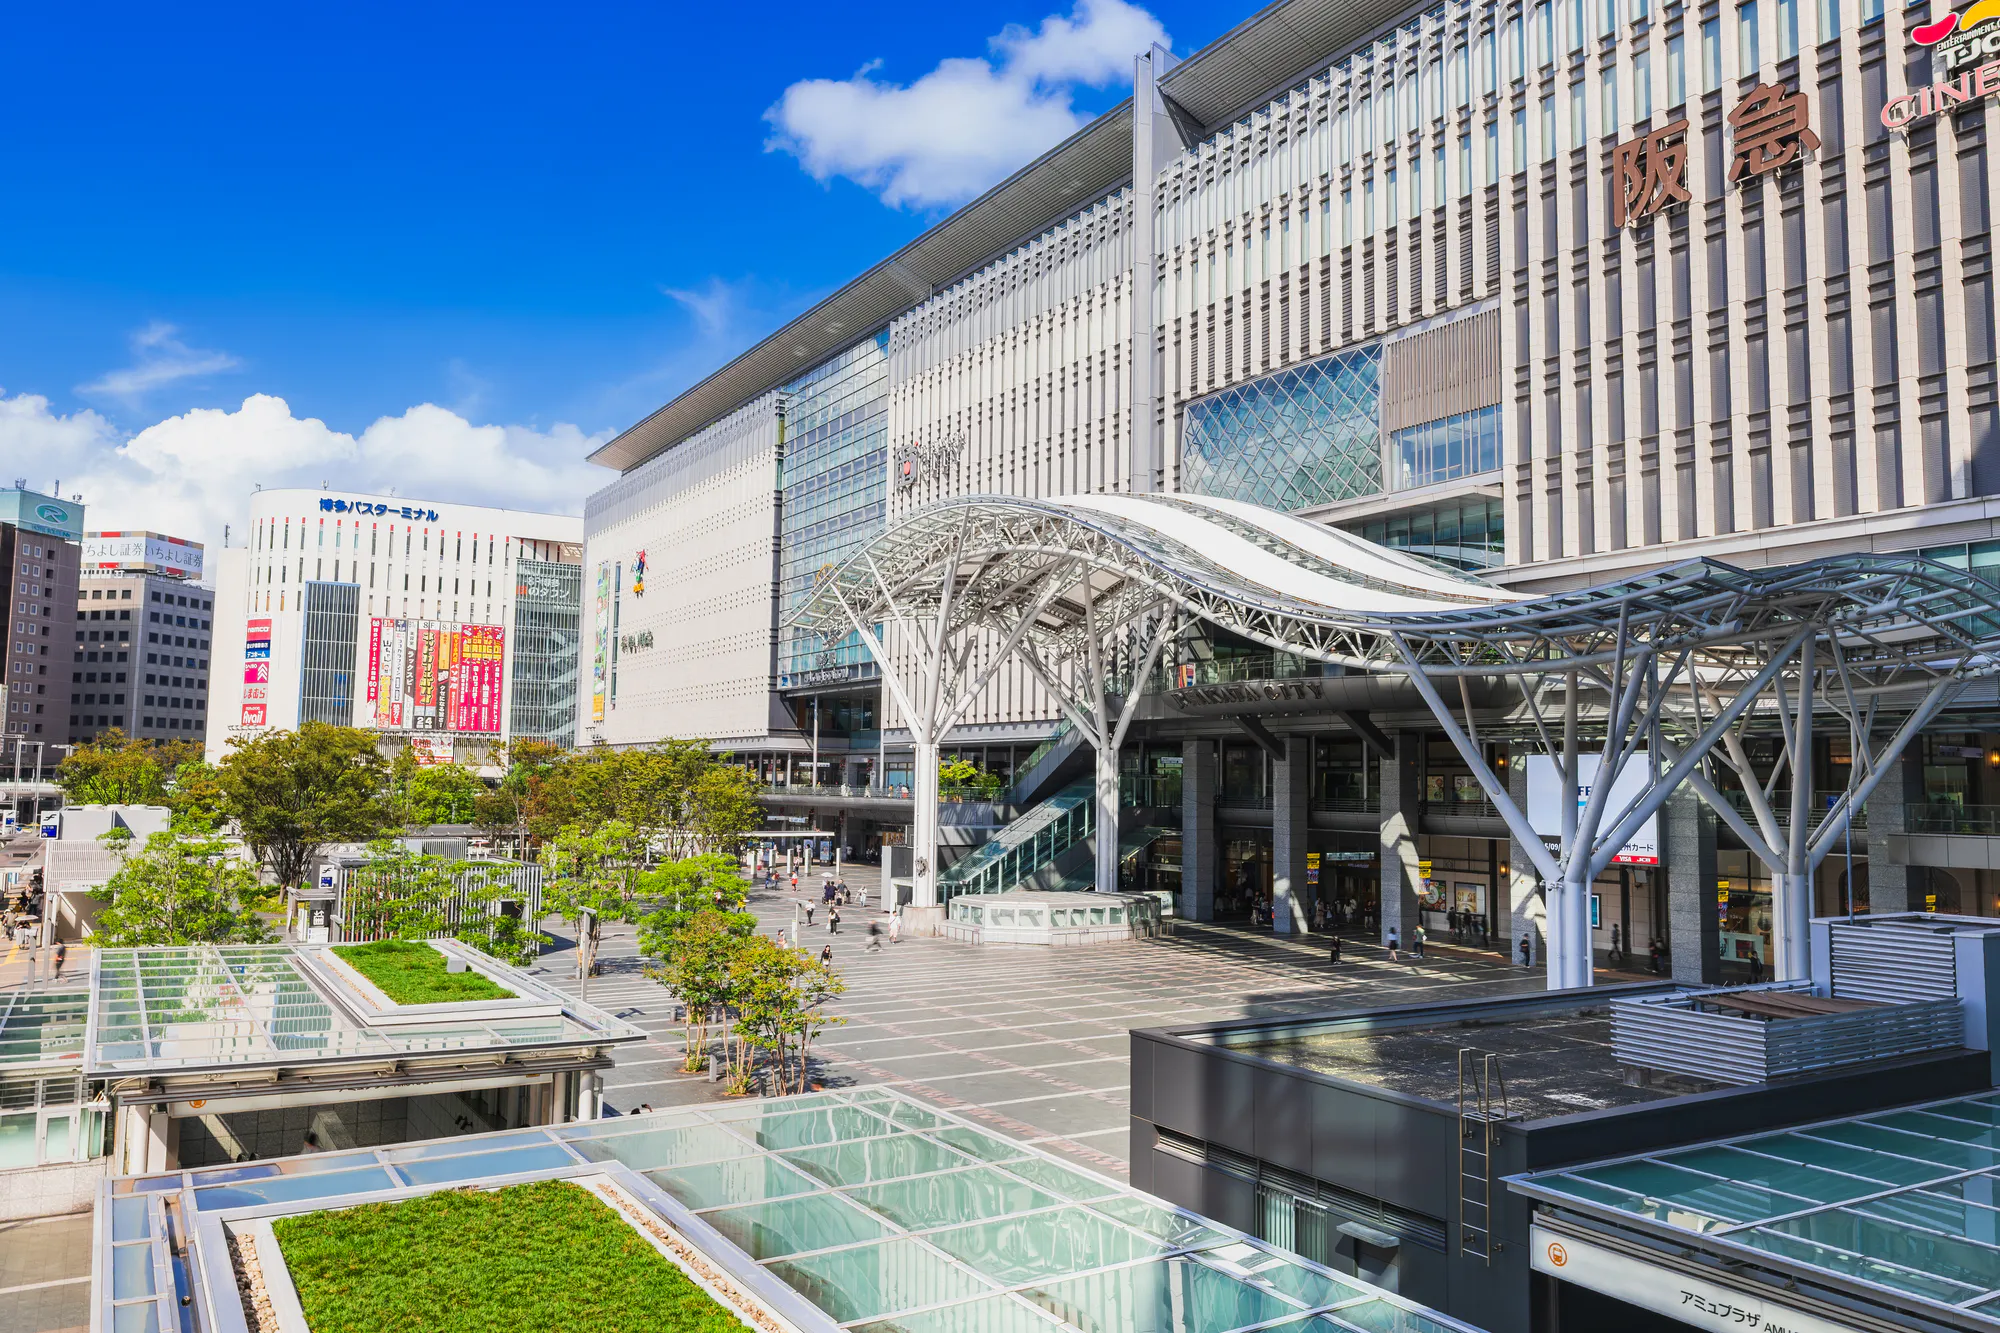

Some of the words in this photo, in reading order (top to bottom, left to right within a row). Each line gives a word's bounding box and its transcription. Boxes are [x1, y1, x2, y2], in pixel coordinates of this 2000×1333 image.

[1613, 82, 1821, 227] 阪急
[319, 497, 439, 522] 博多バスターミナル
[82, 543, 143, 556] ちよし証券
[145, 546, 202, 568] いちよし証券
[243, 687, 266, 699] しまむら
[1263, 681, 1323, 700] CITY
[243, 710, 264, 724] Avail
[1681, 1290, 1761, 1327] アミュプラザ
